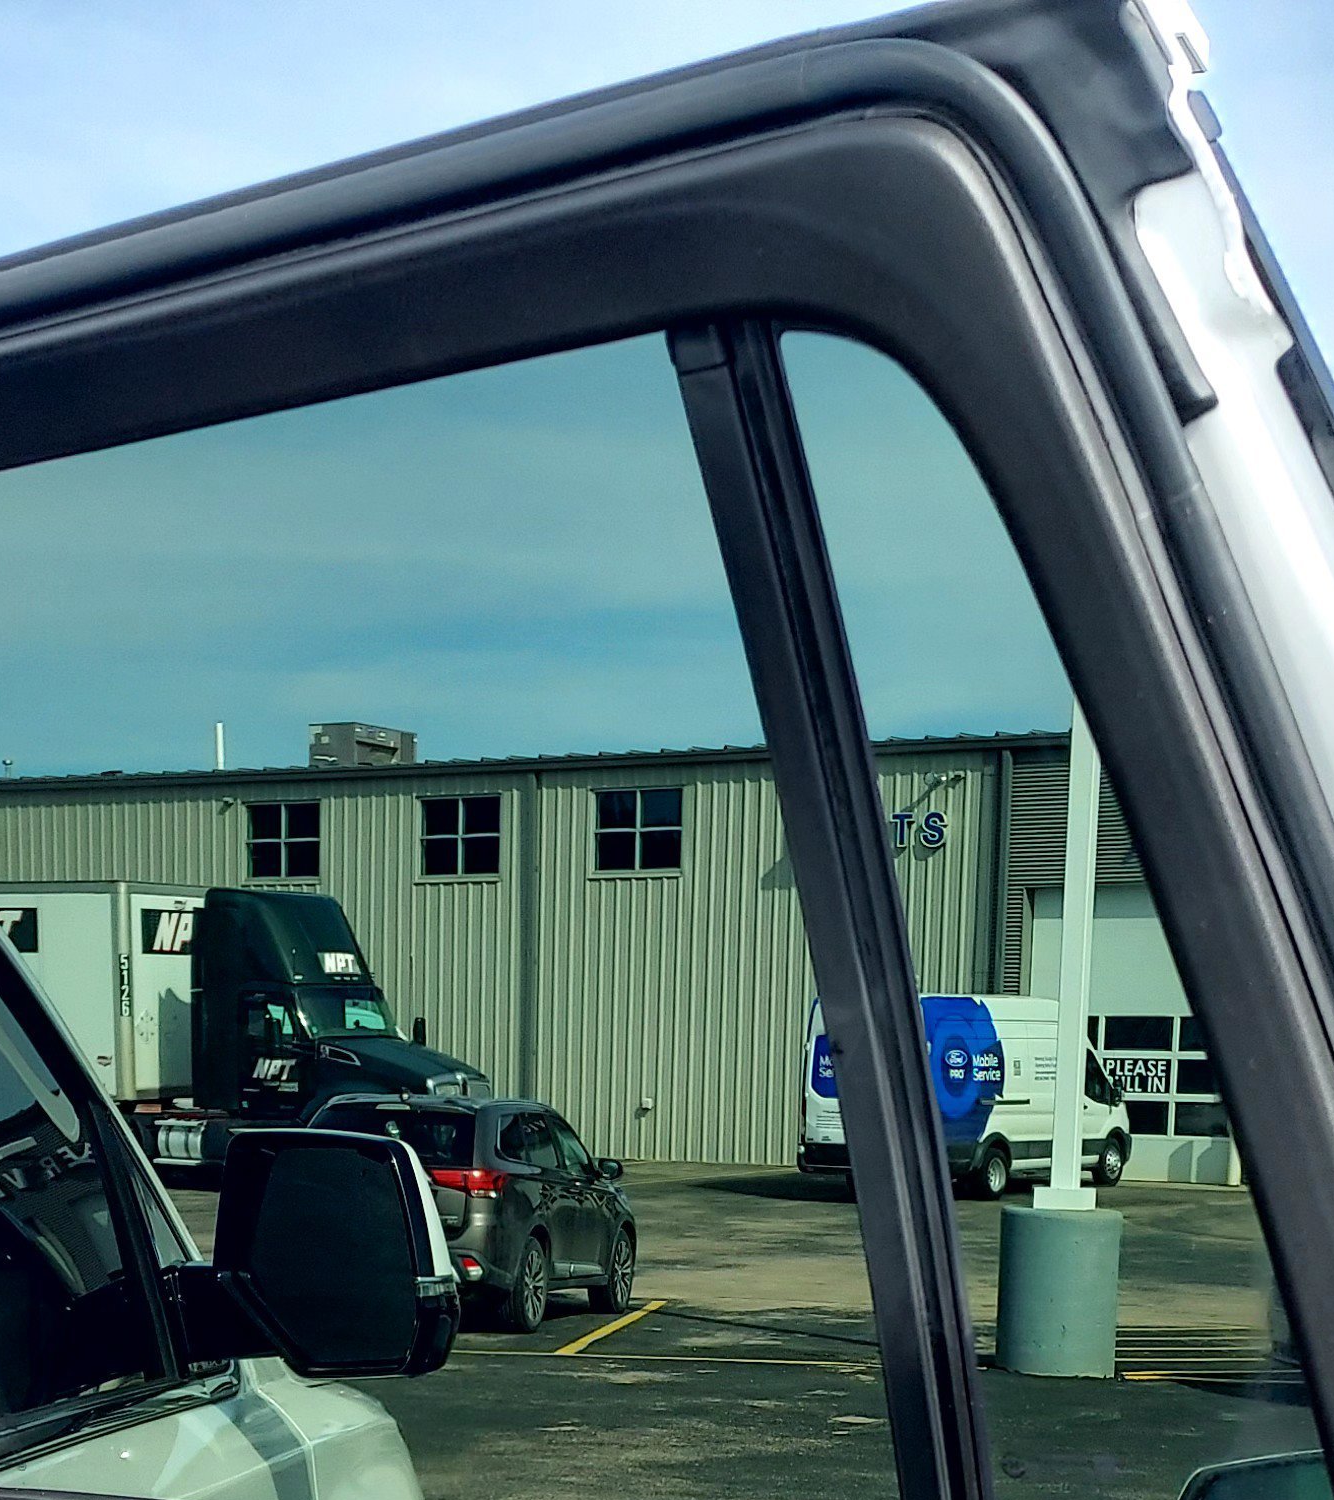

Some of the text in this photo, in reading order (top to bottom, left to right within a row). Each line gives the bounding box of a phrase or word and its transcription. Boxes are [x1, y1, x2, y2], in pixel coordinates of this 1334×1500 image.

[153, 911, 191, 952] NP
[323, 952, 355, 974] NPT
[119, 953, 131, 1018] 5126
[252, 1057, 297, 1081] NPT
[972, 1053, 999, 1067] Mobile
[1106, 1060, 1167, 1077] PLEASE
[972, 1068, 1002, 1081] Service
[1147, 1077, 1166, 1092] IN
